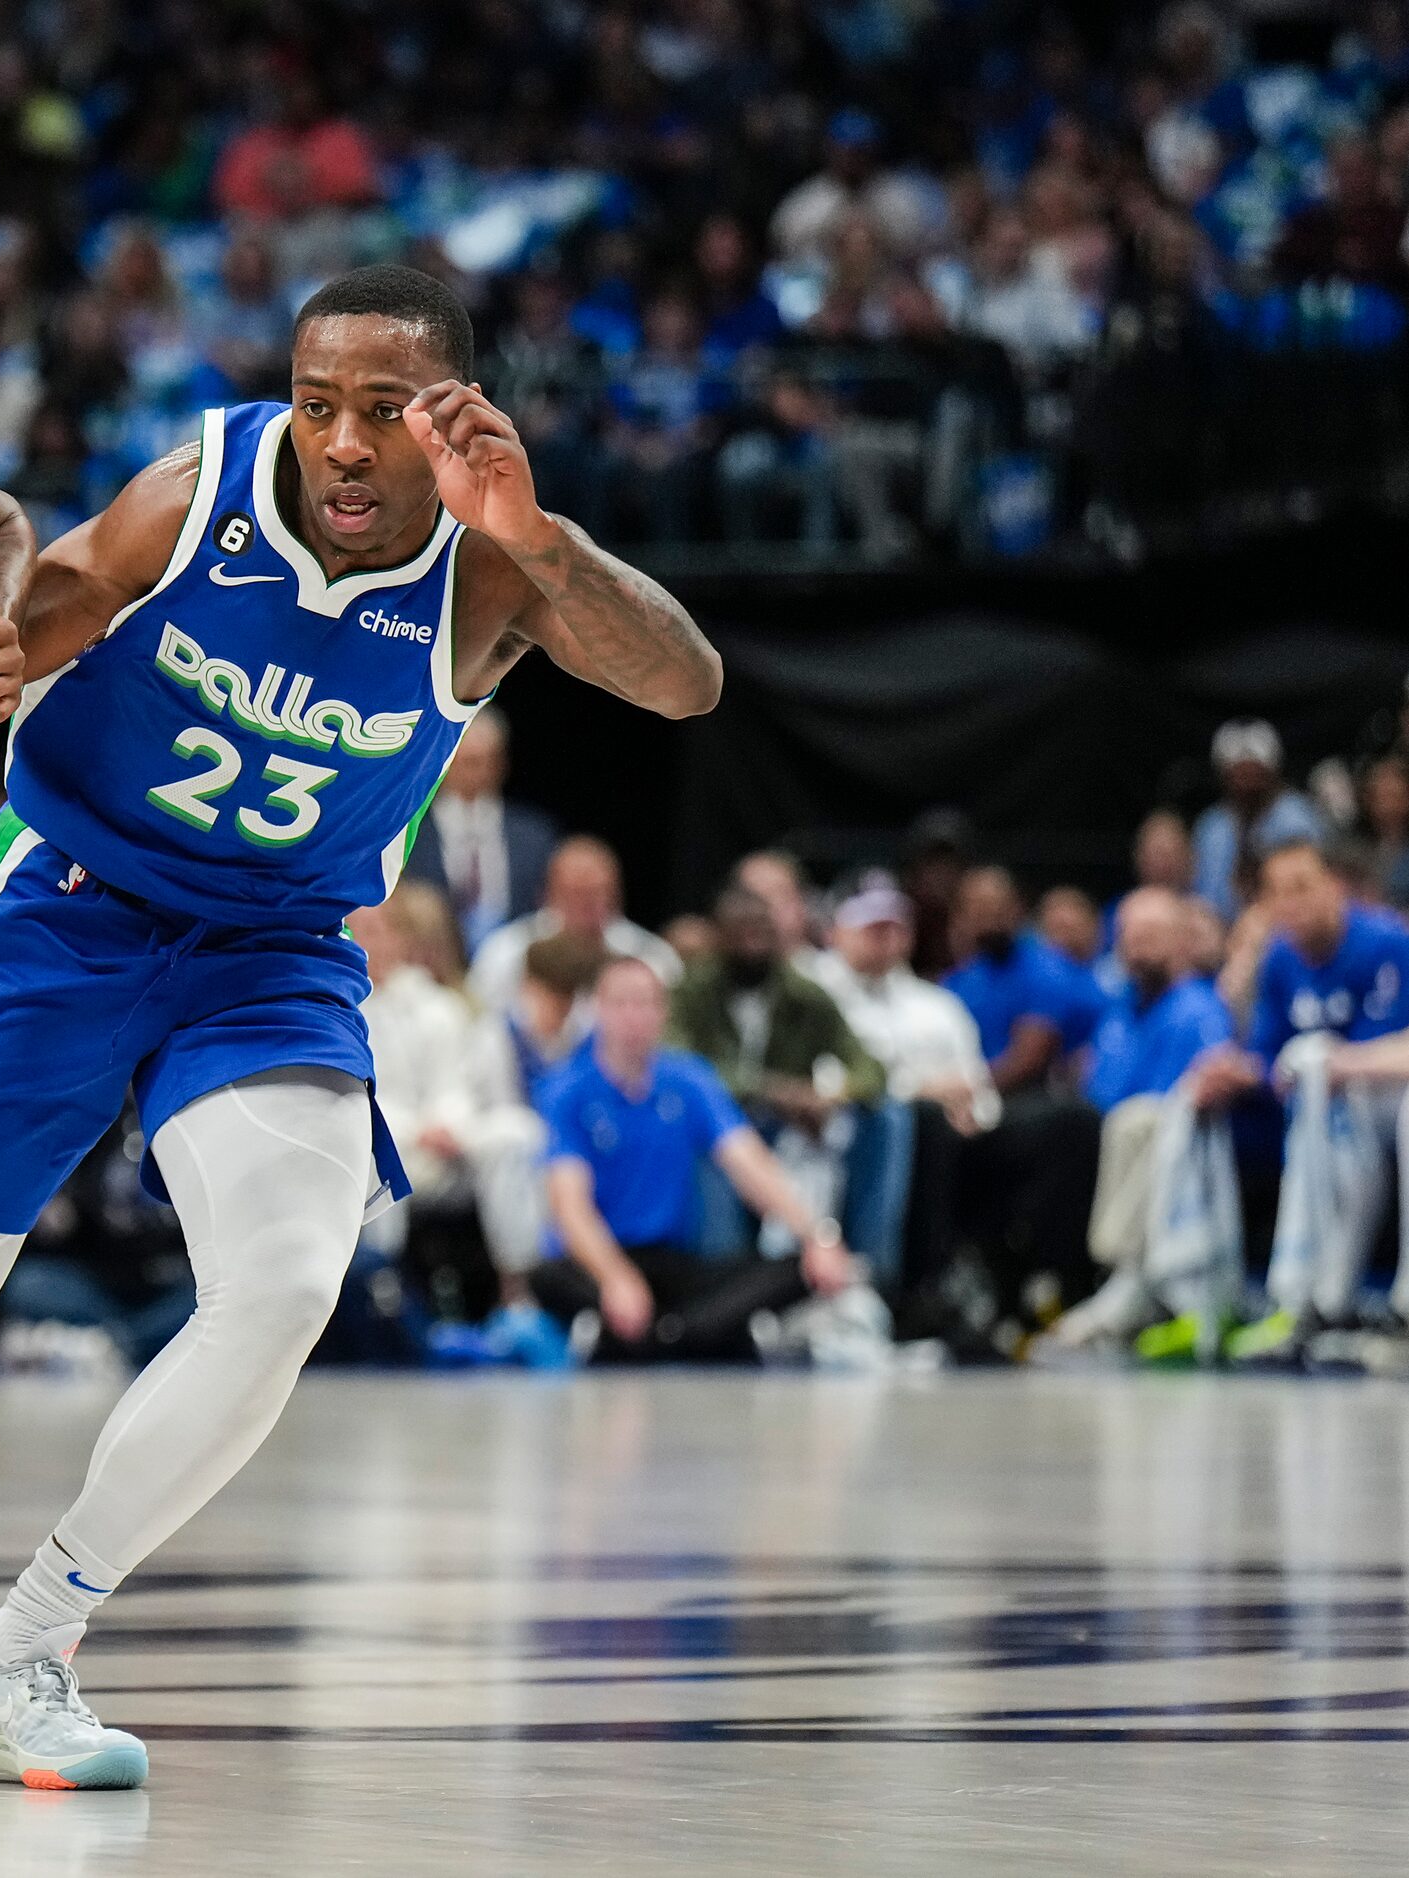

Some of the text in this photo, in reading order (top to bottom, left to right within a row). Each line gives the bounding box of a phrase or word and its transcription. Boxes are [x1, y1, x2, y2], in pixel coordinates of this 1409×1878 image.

[219, 517, 249, 553] 6
[358, 609, 433, 645] chime
[154, 621, 424, 758] Dallas
[145, 726, 339, 848] 23
